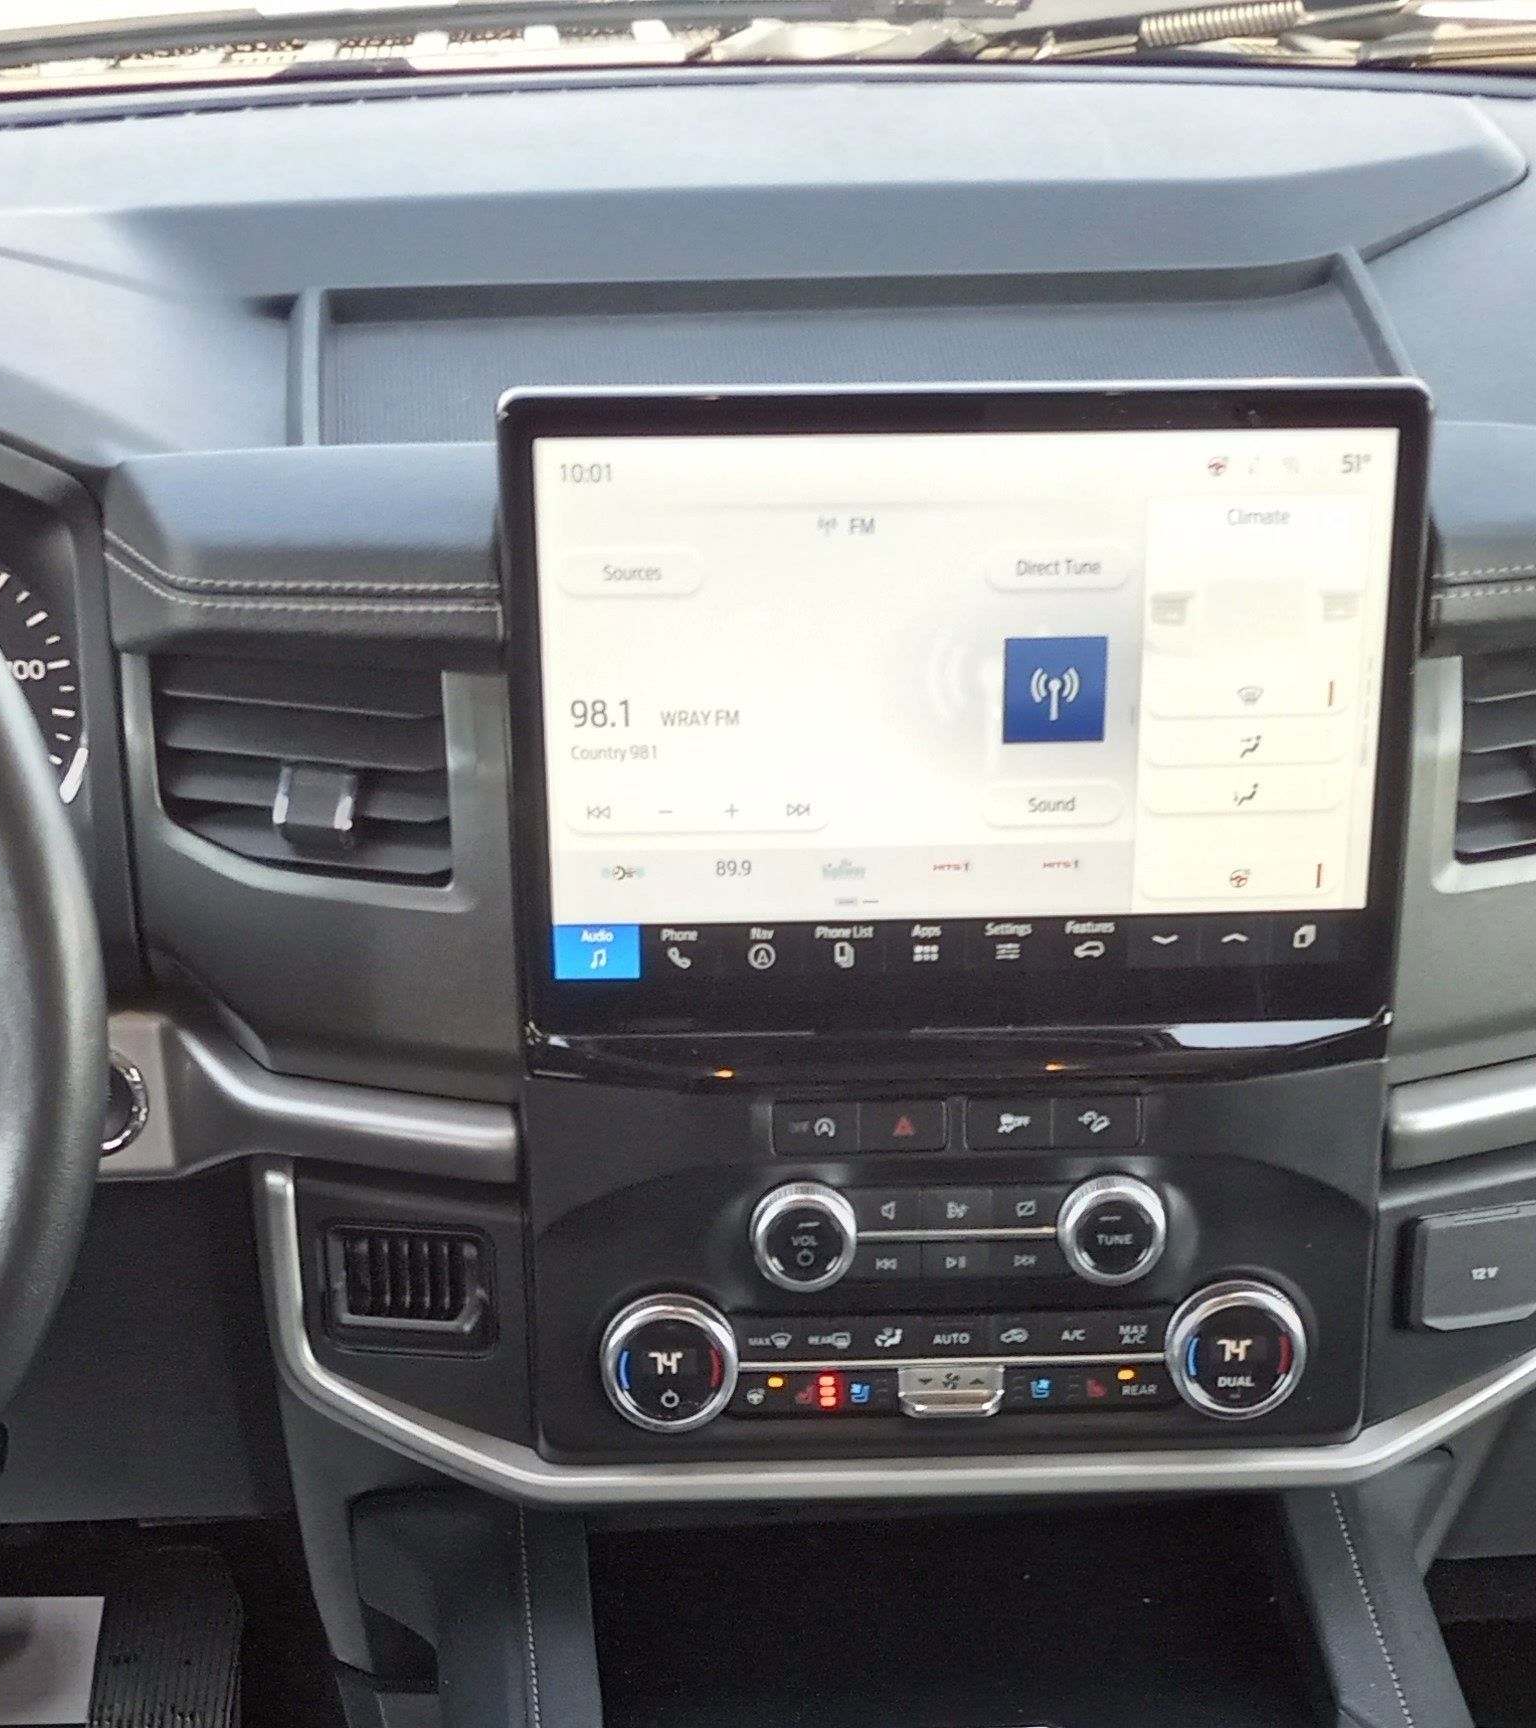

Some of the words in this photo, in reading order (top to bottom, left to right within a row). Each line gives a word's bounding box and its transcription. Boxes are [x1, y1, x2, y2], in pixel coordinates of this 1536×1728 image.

[560, 463, 613, 483] 10:01
[1227, 508, 1290, 526] Climate
[849, 517, 876, 535] FM
[603, 564, 663, 582] Sources
[1016, 559, 1061, 576] Direct
[1064, 558, 1102, 575] Tune
[7, 660, 46, 680] 00
[570, 699, 631, 728] 98.1
[660, 711, 711, 728] WRAY
[714, 709, 740, 727] FM
[571, 745, 627, 763] Country
[1027, 797, 1076, 813] Sound
[715, 860, 752, 877] 89.9
[581, 928, 613, 943] Audio
[661, 928, 698, 943] Phone
[750, 927, 775, 941] Nav
[815, 925, 851, 940] Phone
[853, 924, 874, 939] List
[911, 924, 942, 939] Apps
[984, 922, 1033, 938] Settings
[1065, 921, 1115, 936] Features
[791, 1234, 818, 1247] VOL
[1097, 1234, 1134, 1246] TUNE
[1471, 1266, 1499, 1281] 12V
[1061, 1329, 1086, 1343] A/C
[1119, 1324, 1147, 1335] MAX
[748, 1336, 772, 1347] MAX
[932, 1333, 970, 1345] AUTO
[1121, 1333, 1146, 1345] A/C
[1122, 1384, 1157, 1396] REAR
[1217, 1376, 1255, 1389] DUAL
